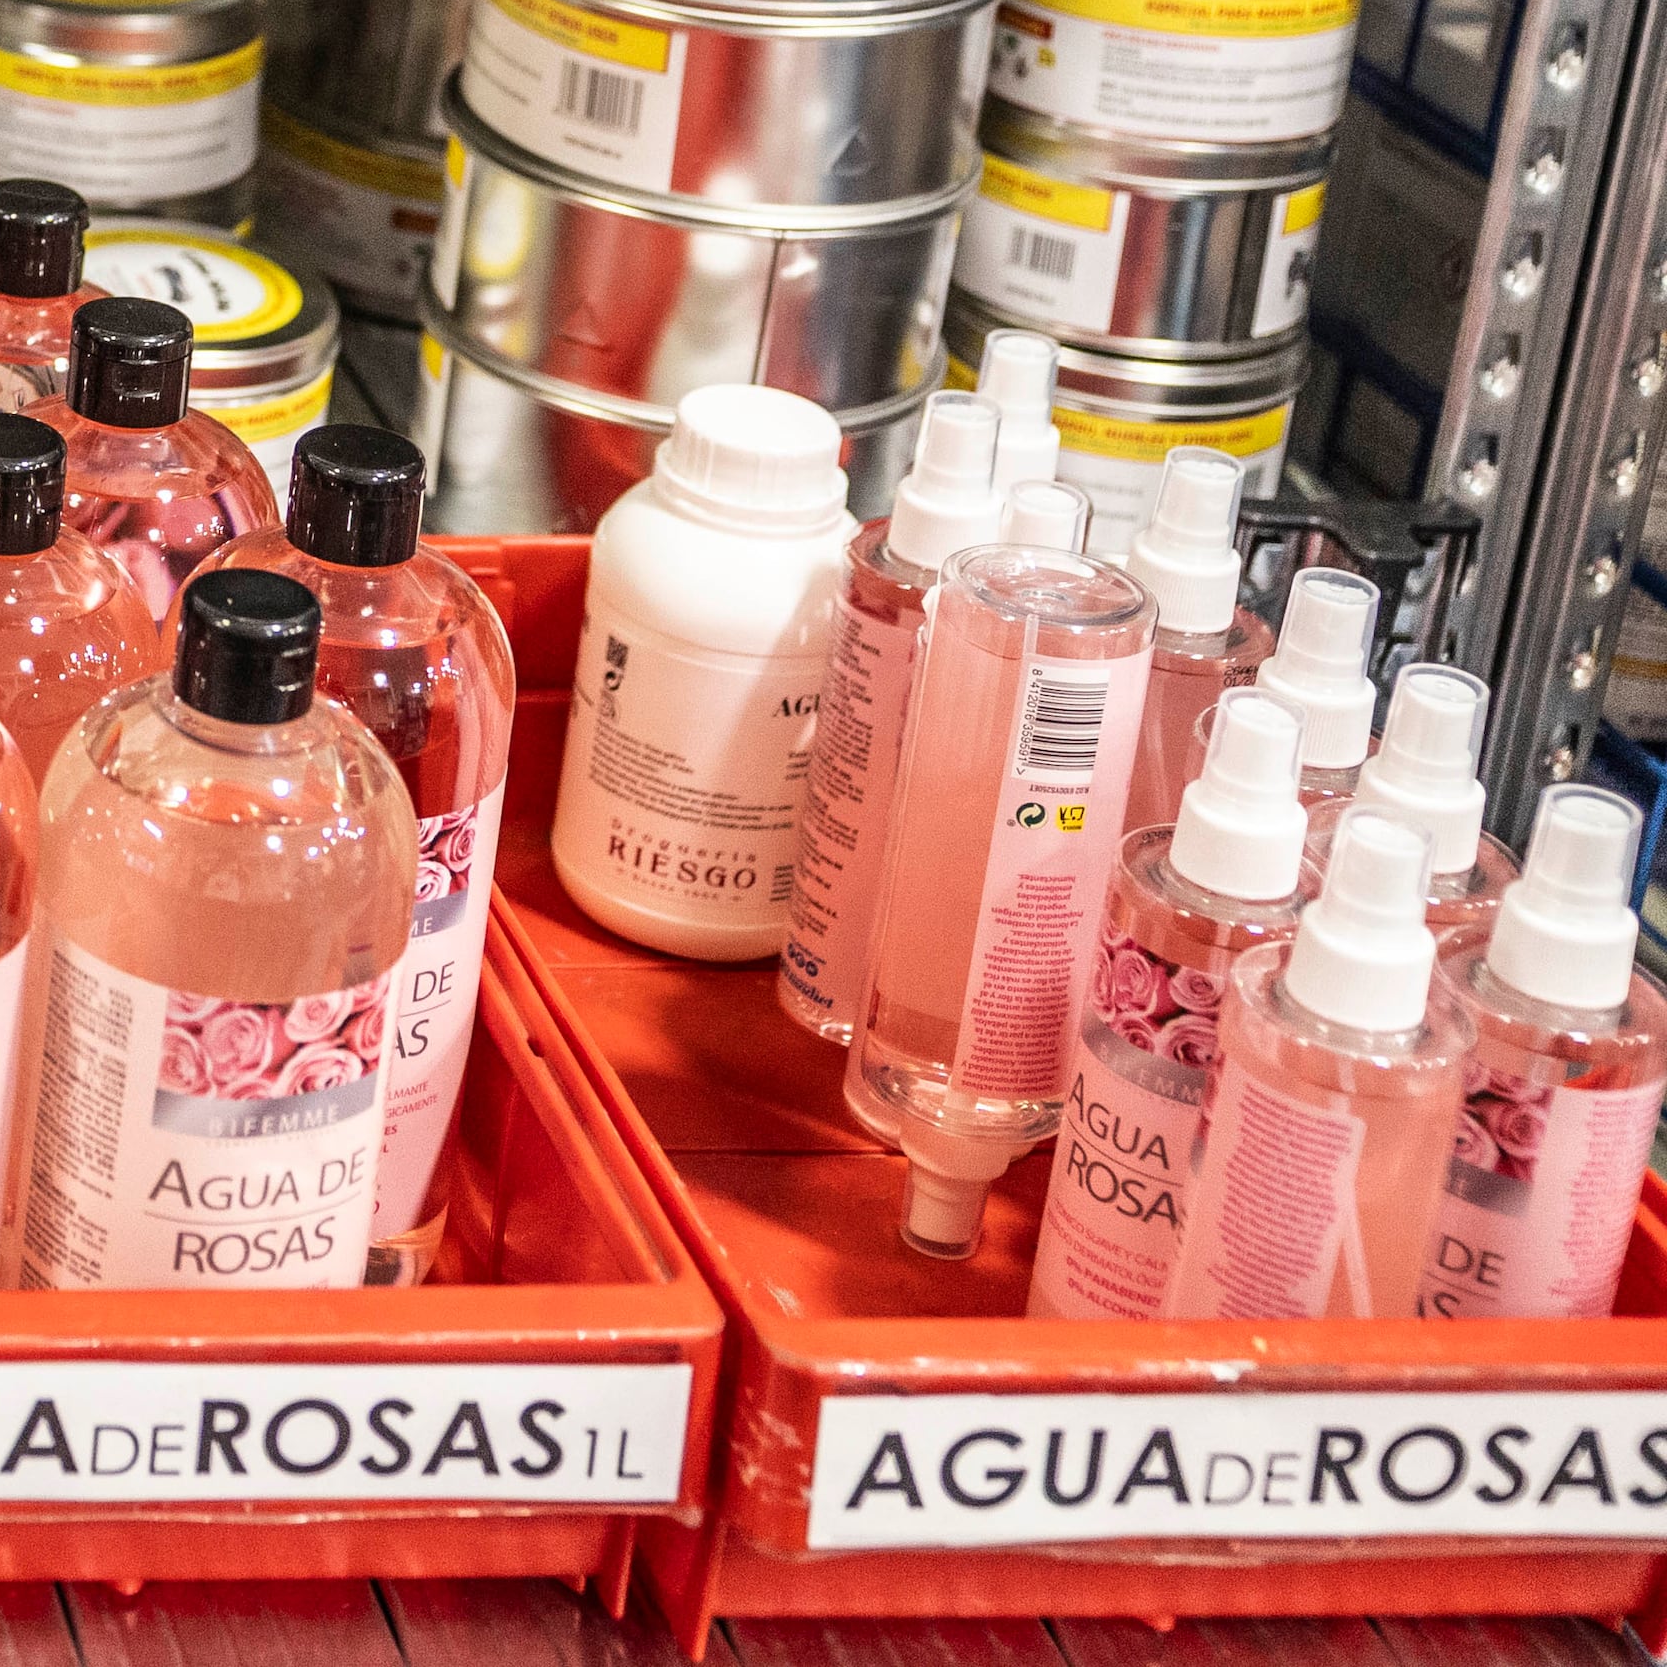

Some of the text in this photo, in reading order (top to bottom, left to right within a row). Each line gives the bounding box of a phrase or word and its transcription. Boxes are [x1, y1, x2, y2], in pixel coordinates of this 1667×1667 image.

[1017, 668, 1043, 762] 8 412016 359591
[609, 834, 757, 890] RIESGO
[411, 960, 455, 1004] DE
[208, 1102, 340, 1136] BIFEMME
[1068, 1072, 1170, 1171] AGUA
[149, 1147, 366, 1212] AGUA DE
[172, 1215, 337, 1276] ROSAS
[1437, 1236, 1506, 1286] DE
